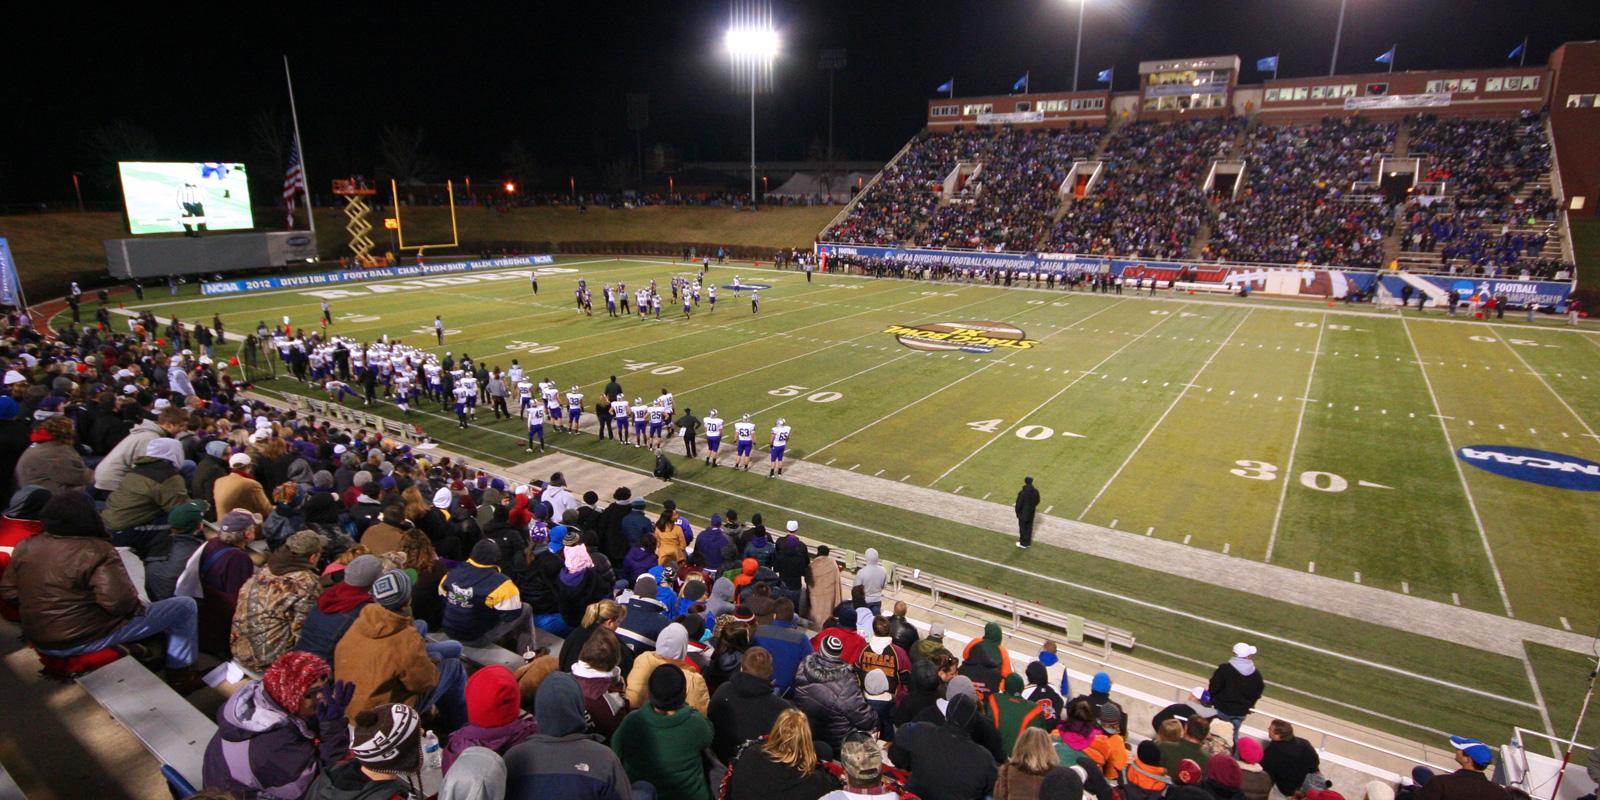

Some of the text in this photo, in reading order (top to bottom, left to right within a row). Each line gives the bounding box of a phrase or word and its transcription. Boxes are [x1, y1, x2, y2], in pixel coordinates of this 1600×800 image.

[914, 254, 942, 264] DIVISION
[950, 256, 982, 266] FOOTBALL
[982, 258, 1036, 270] CHAMPIONSHIP
[1066, 263, 1100, 274] VIRGINIA
[205, 284, 238, 294] NCAA
[246, 280, 272, 289] 2012
[280, 276, 326, 286] DIVISION
[328, 274, 338, 282] III
[343, 270, 394, 280] FOOTBALL
[494, 257, 531, 266] VIRGINIA
[534, 255, 552, 263] NCAA
[1494, 282, 1538, 294] FOOTBALL
[882, 326, 951, 340] BOWL
[505, 340, 561, 354] 30
[624, 359, 684, 375] 40
[768, 385, 844, 403] 50
[535, 410, 544, 418] 45
[615, 406, 624, 414] 16
[636, 410, 644, 418] 18
[652, 411, 660, 420] 25
[708, 422, 717, 432] 70
[739, 428, 750, 437] 63
[966, 419, 1055, 441] 40
[1461, 448, 1600, 476] NCAA
[1230, 459, 1348, 492] 30
[862, 651, 895, 668] ITHACA
